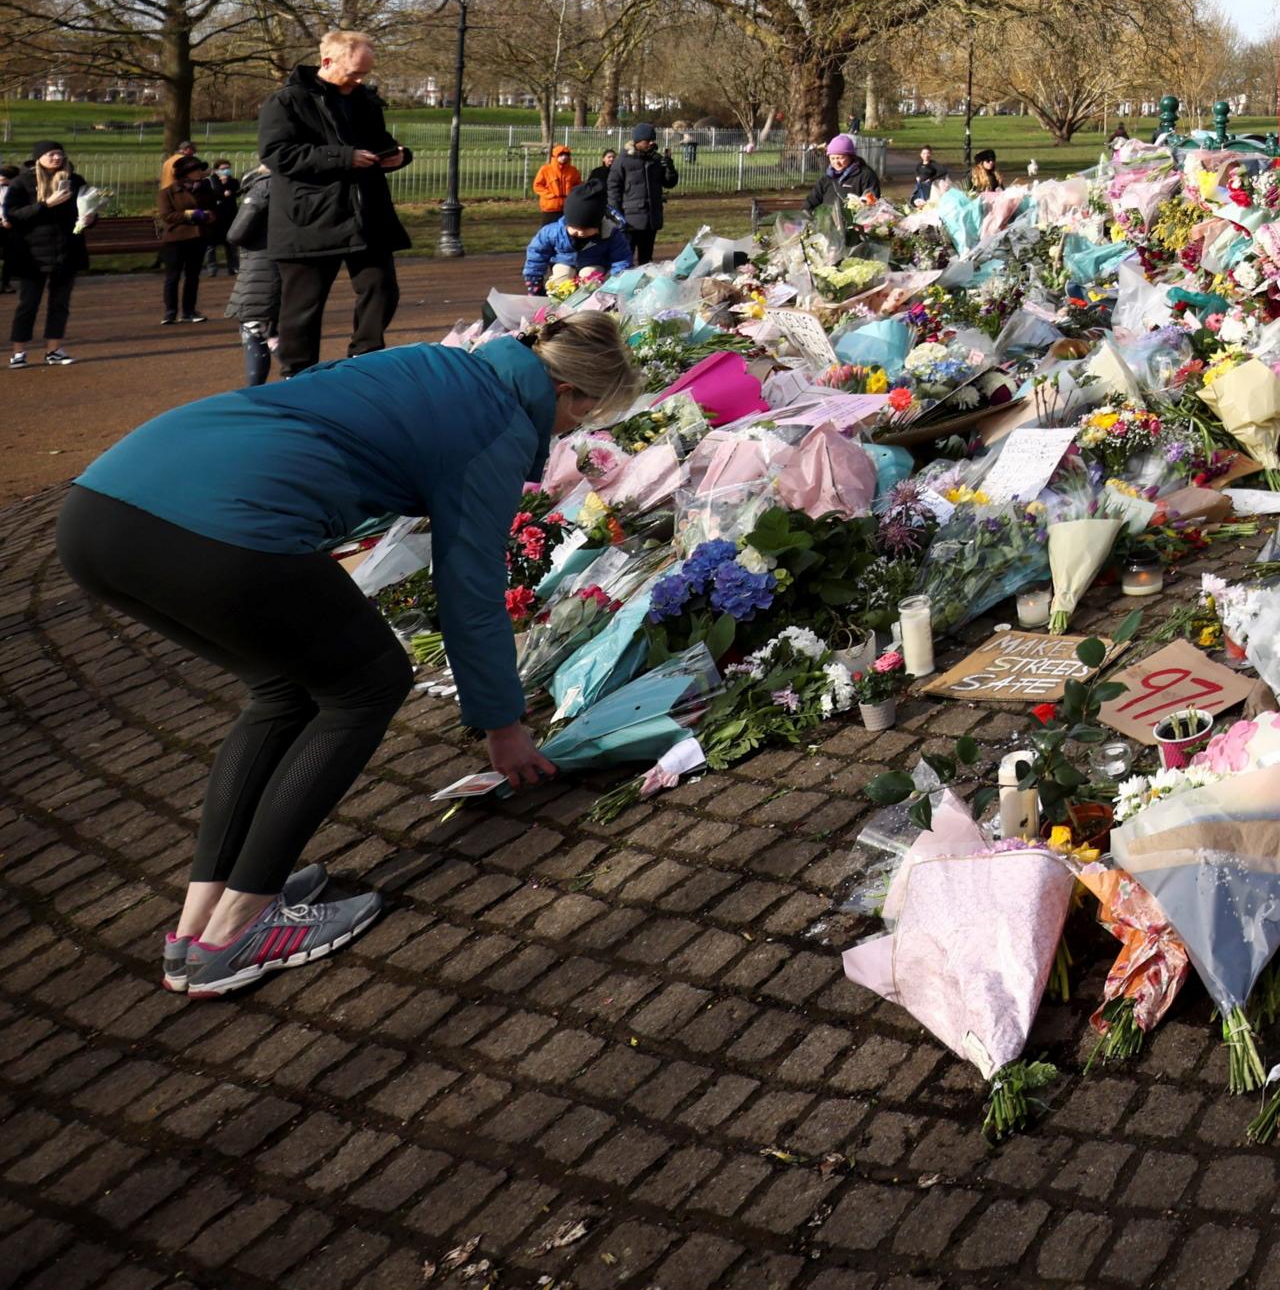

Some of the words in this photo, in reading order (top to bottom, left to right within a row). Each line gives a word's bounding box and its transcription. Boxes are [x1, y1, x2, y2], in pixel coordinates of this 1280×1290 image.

[983, 634, 1071, 658] MAKE
[985, 656, 1089, 677] STREETS
[951, 673, 1062, 694] SAFE
